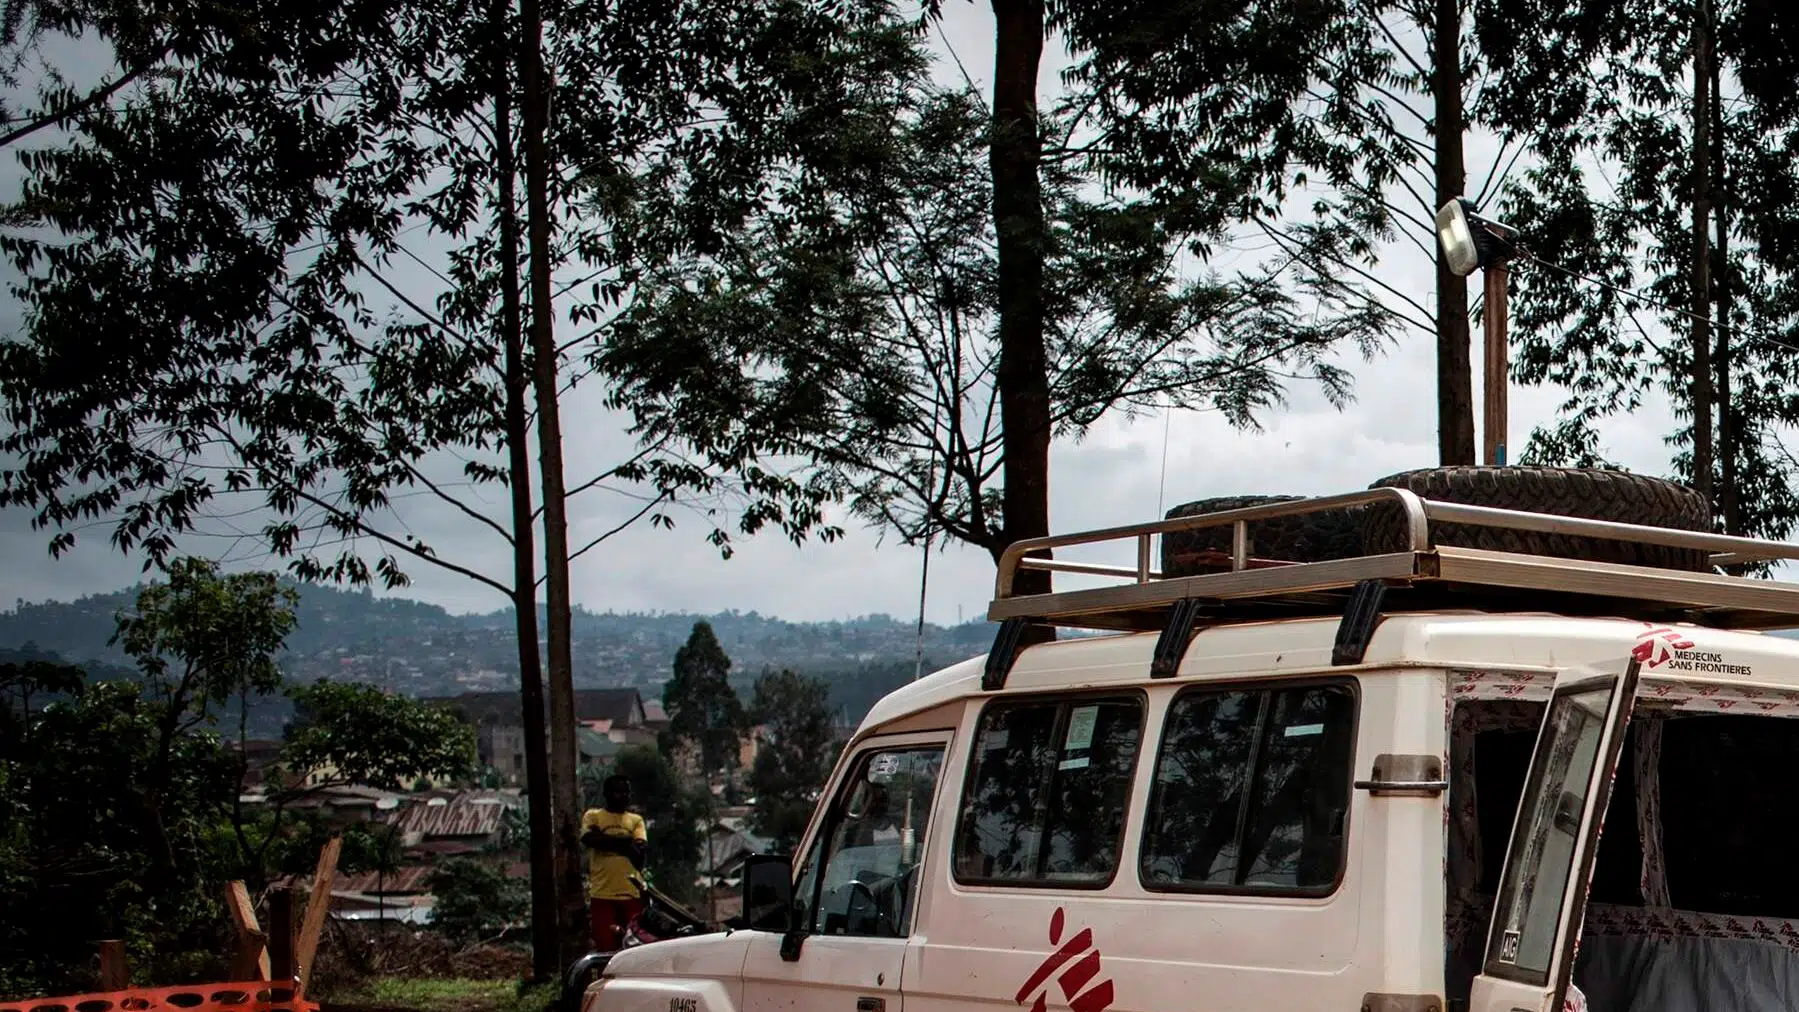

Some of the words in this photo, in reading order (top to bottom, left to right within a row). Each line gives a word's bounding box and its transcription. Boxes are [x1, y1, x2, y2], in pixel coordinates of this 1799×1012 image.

[1674, 651, 1722, 663] MEDECINS
[1668, 660, 1692, 671] SANS
[1695, 662, 1752, 676] FRONTIERES
